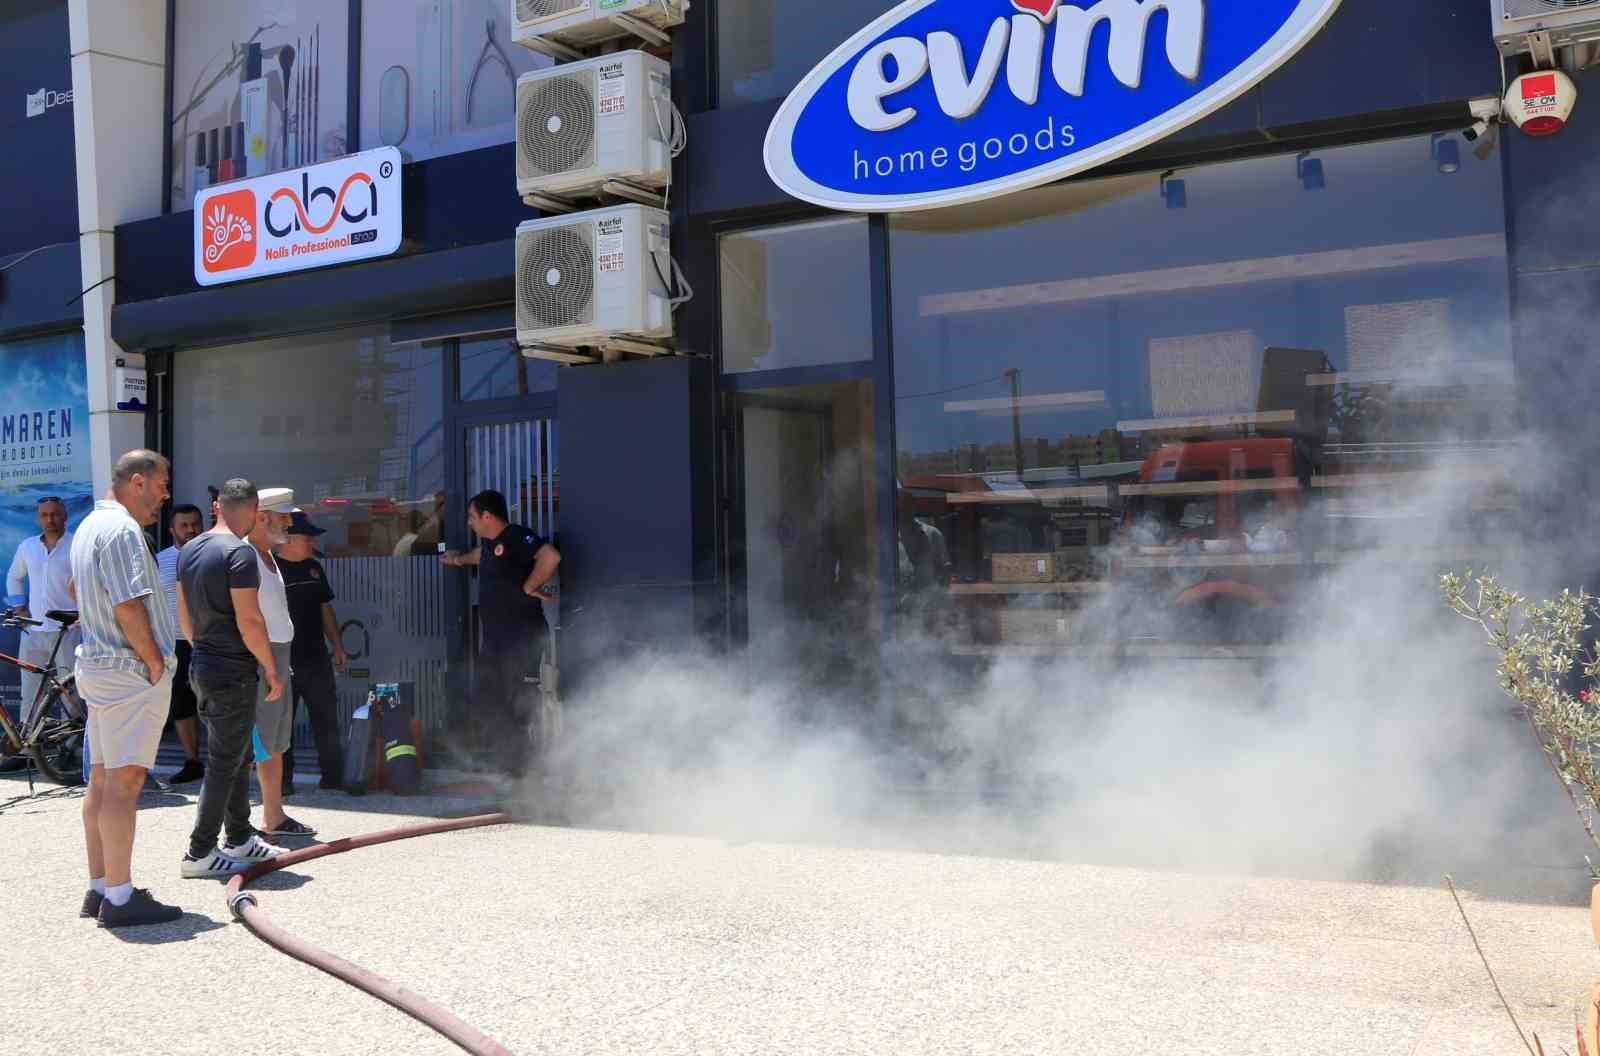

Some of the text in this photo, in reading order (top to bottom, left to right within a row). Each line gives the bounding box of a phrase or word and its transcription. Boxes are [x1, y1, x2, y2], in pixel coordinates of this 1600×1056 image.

[847, 0, 1205, 132] evim
[264, 171, 378, 238] aba
[265, 247, 289, 261] Nails
[291, 234, 350, 257] Professional
[2, 408, 72, 444] MAREN
[2, 442, 72, 461] ROBOTICS
